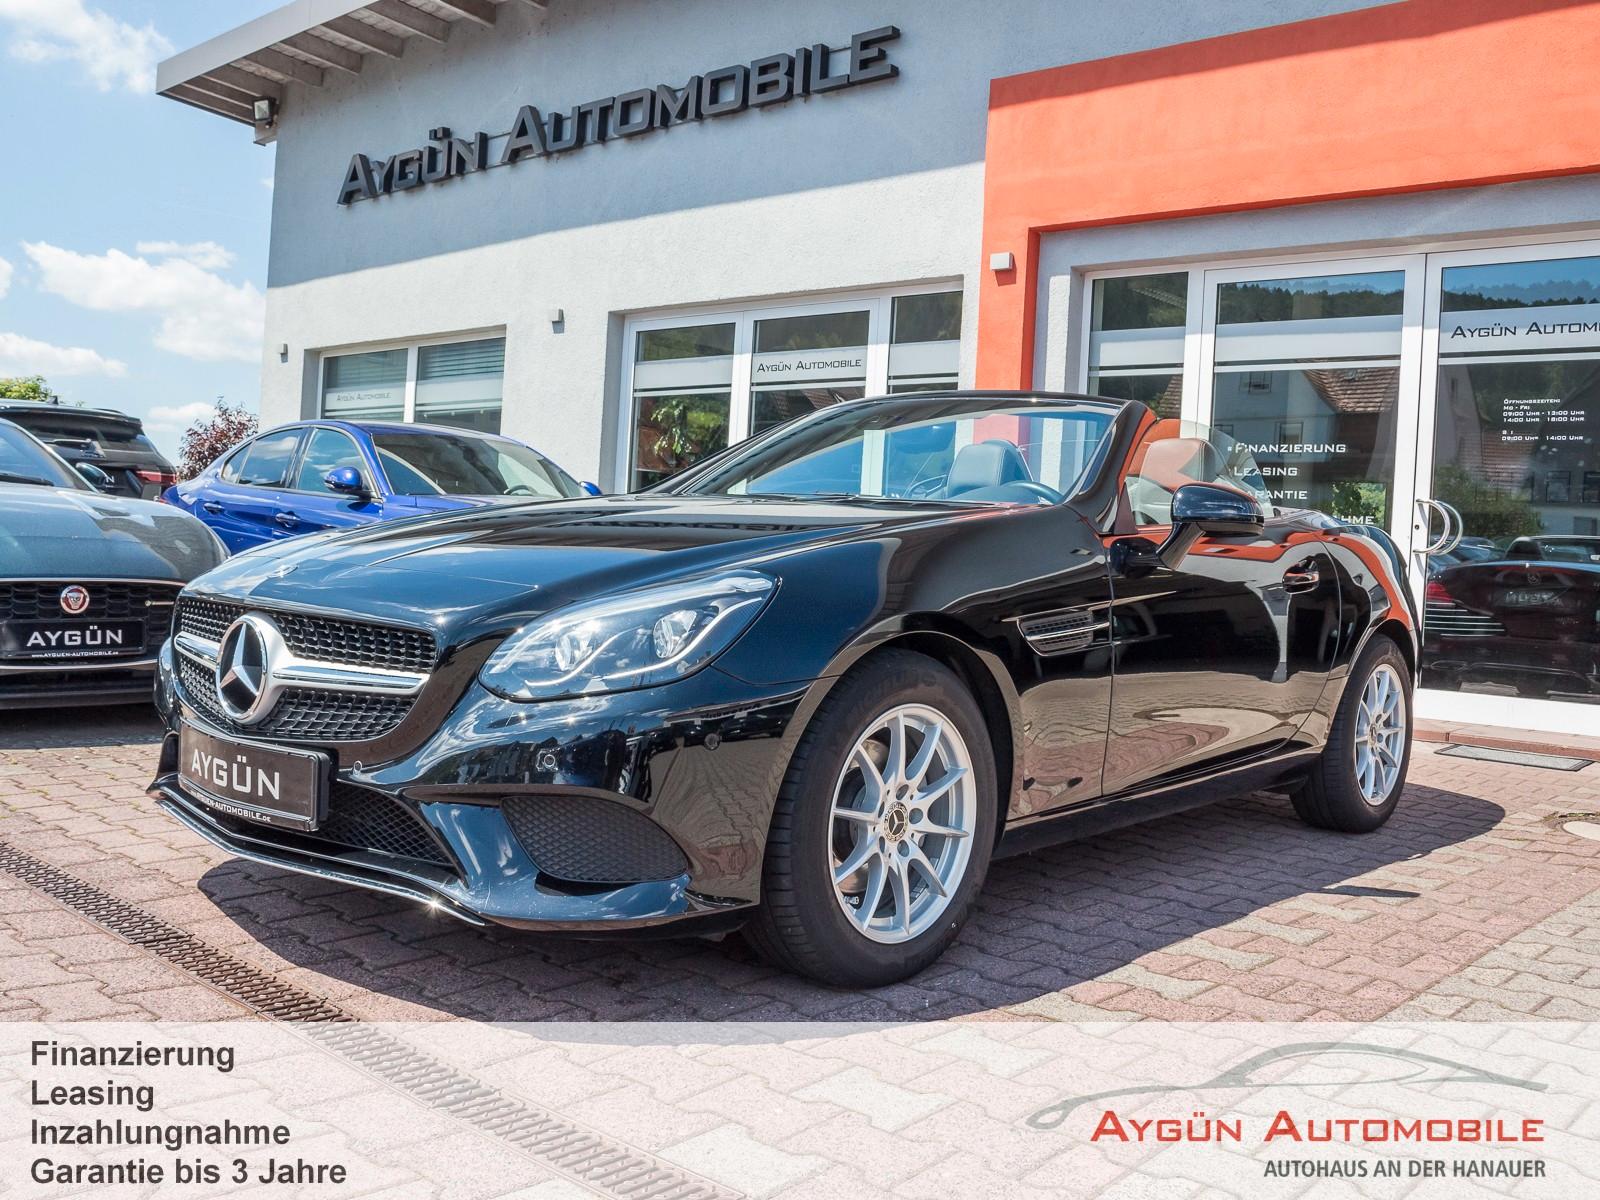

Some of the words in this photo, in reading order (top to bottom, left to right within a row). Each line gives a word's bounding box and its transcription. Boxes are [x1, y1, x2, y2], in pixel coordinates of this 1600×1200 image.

[501, 25, 900, 164] AUTOMOBILE
[1450, 323, 1517, 338] AYGÜN
[757, 362, 792, 373] AYGÜN
[796, 359, 862, 371] AUTOMOBILE
[1234, 466, 1298, 476] LEASING
[26, 625, 123, 647] AYGÜN
[191, 748, 280, 800] AYGÜN
